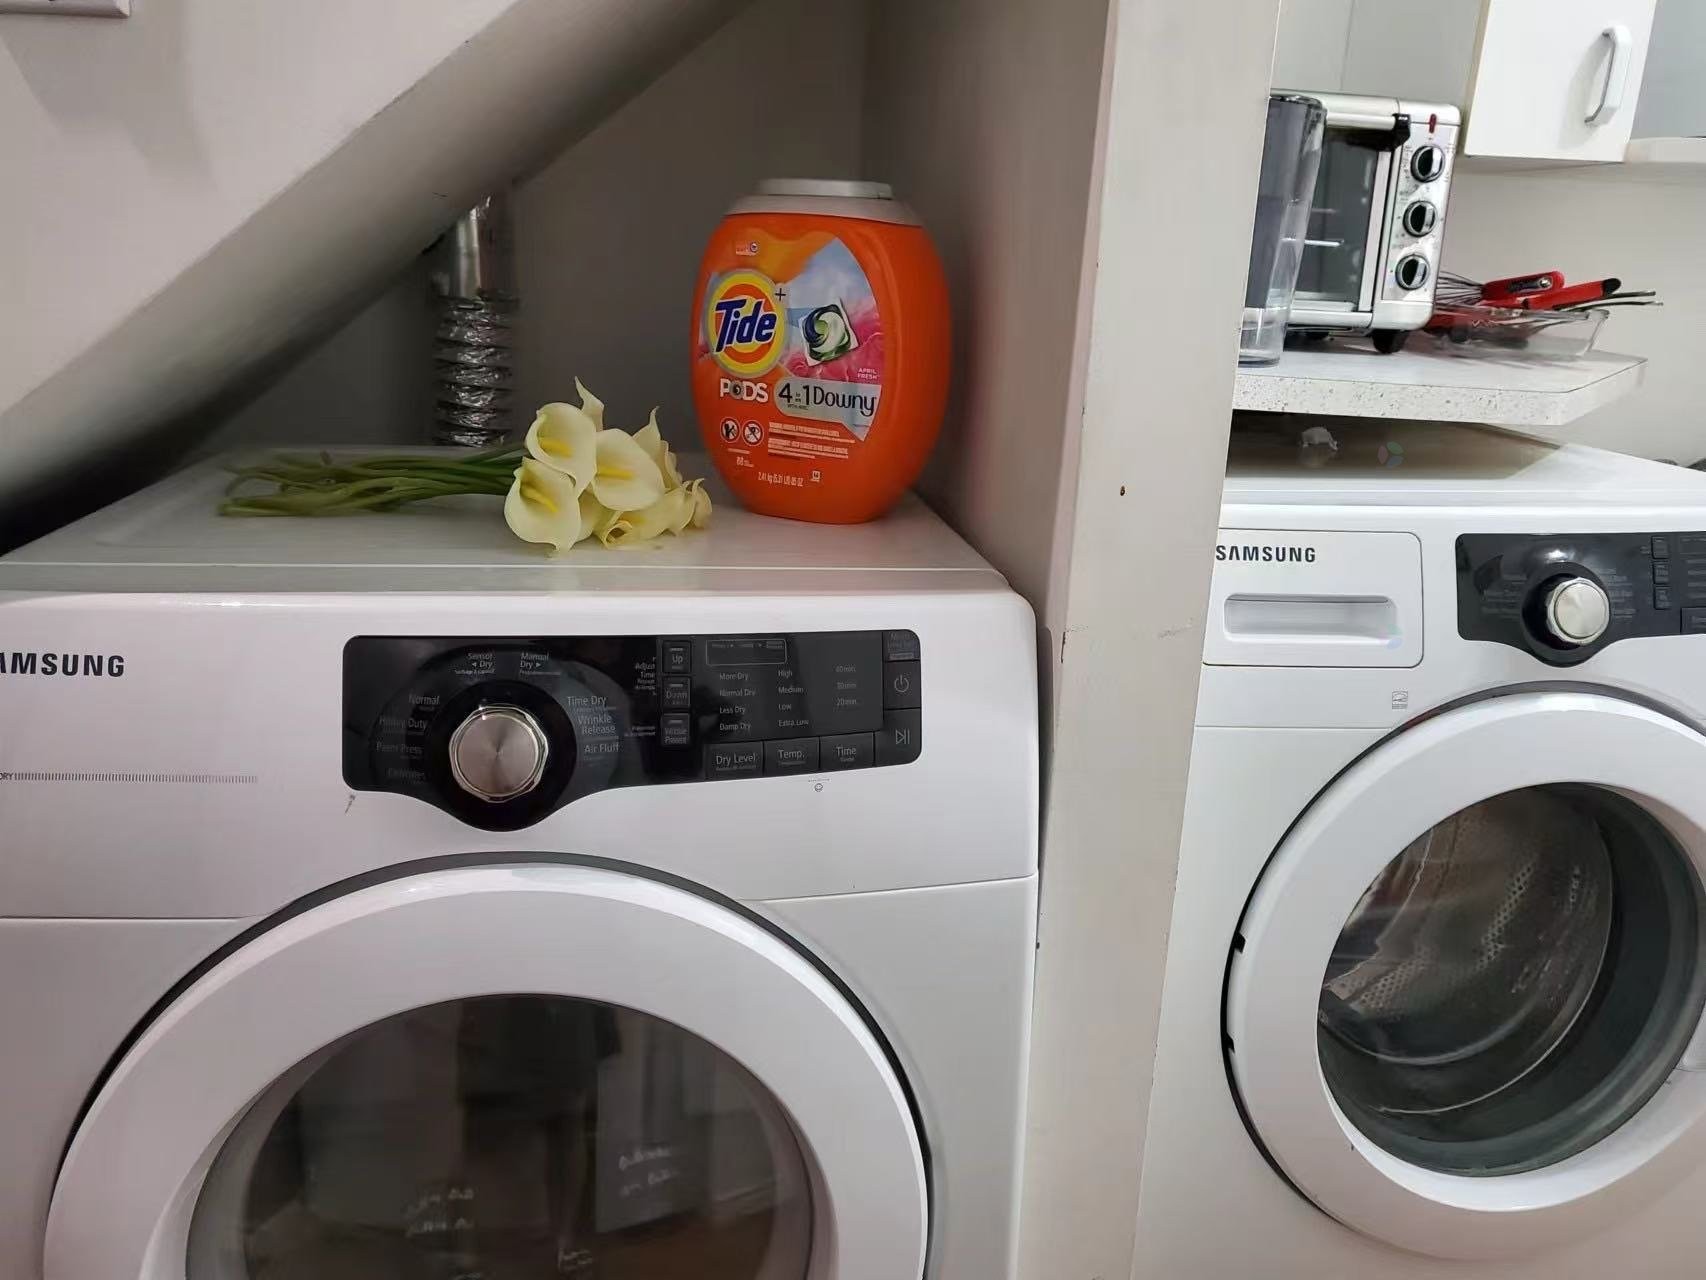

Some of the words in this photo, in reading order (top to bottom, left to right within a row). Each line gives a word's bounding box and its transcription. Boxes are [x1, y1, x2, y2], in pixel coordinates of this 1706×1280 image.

[714, 298, 777, 353] Tide
[719, 378, 769, 403] PODS
[778, 382, 792, 404] 4
[802, 384, 810, 406] 1
[813, 386, 876, 417] Downy
[1215, 544, 1316, 563] SAMSUNG
[520, 651, 550, 660] Manual
[672, 655, 684, 664] Up
[479, 660, 492, 669] Dry
[520, 660, 534, 669] Dry
[778, 670, 793, 680] High
[408, 694, 440, 705] Normal
[567, 696, 589, 706] Time
[590, 696, 607, 707] Dry
[408, 718, 428, 731] Duty
[578, 714, 612, 725] Wrinkle
[584, 744, 597, 754] Air
[600, 742, 620, 753] Fluff
[836, 745, 857, 757] Time
[716, 756, 731, 766] Dry
[734, 752, 756, 764] Level
[778, 749, 805, 760] Temp.
